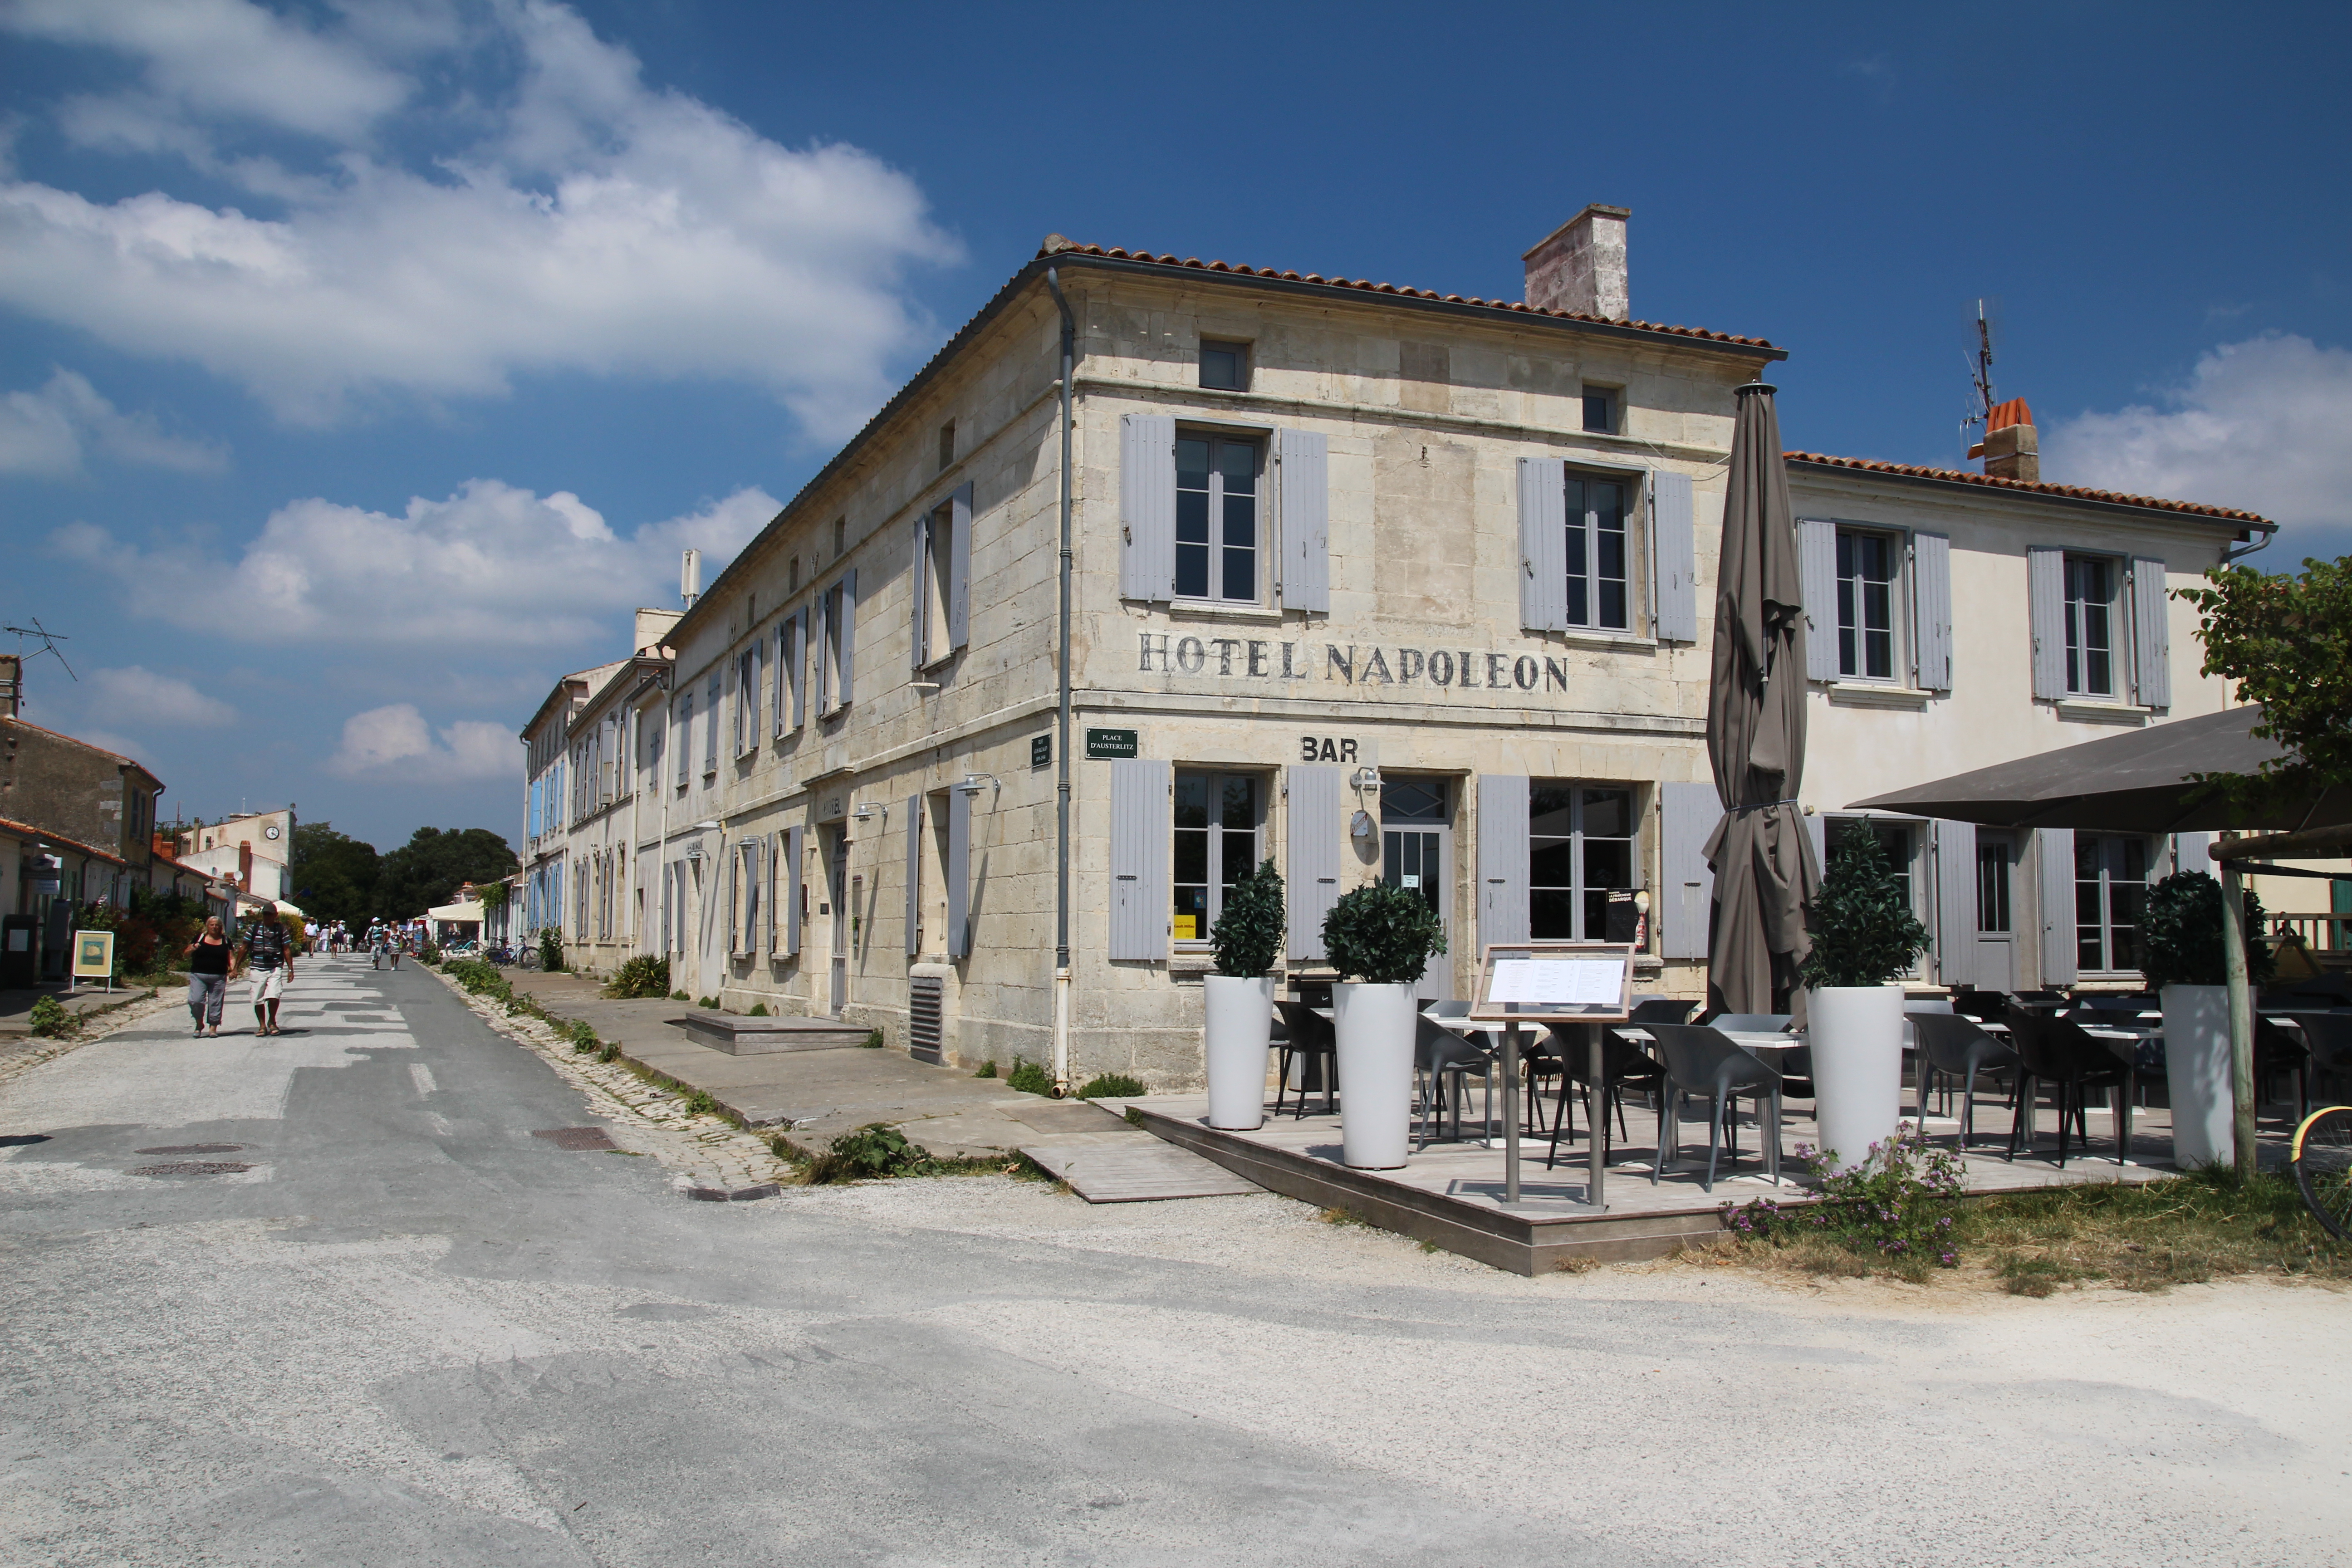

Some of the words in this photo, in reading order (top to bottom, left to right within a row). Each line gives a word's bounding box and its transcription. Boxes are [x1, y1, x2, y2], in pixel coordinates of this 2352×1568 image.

[1138, 633, 1308, 678] HOTEL
[1325, 644, 1568, 693] NAPOLEON
[1302, 736, 1358, 764] BAR
